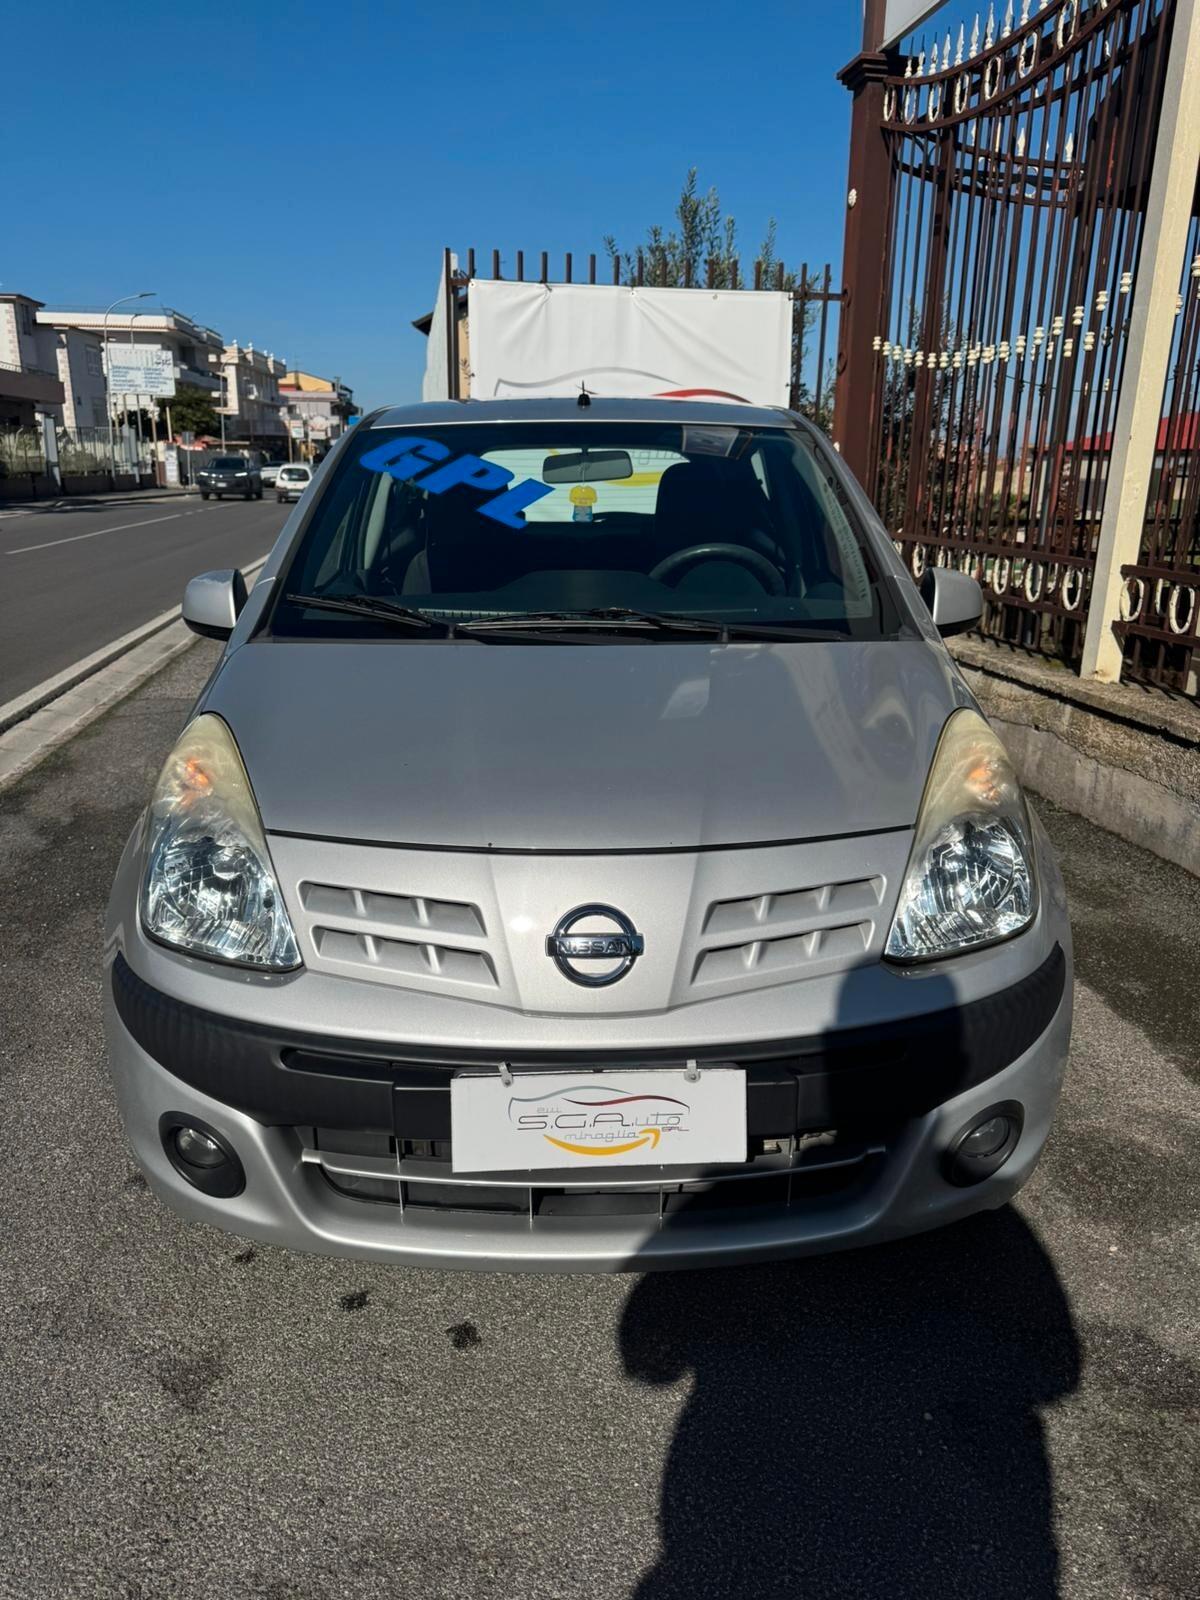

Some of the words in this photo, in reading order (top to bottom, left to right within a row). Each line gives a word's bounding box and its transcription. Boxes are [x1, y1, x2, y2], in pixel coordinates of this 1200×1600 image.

[360, 437, 556, 529] GPL
[556, 940, 634, 954] NISSAN
[564, 1129, 640, 1143] miraglia
